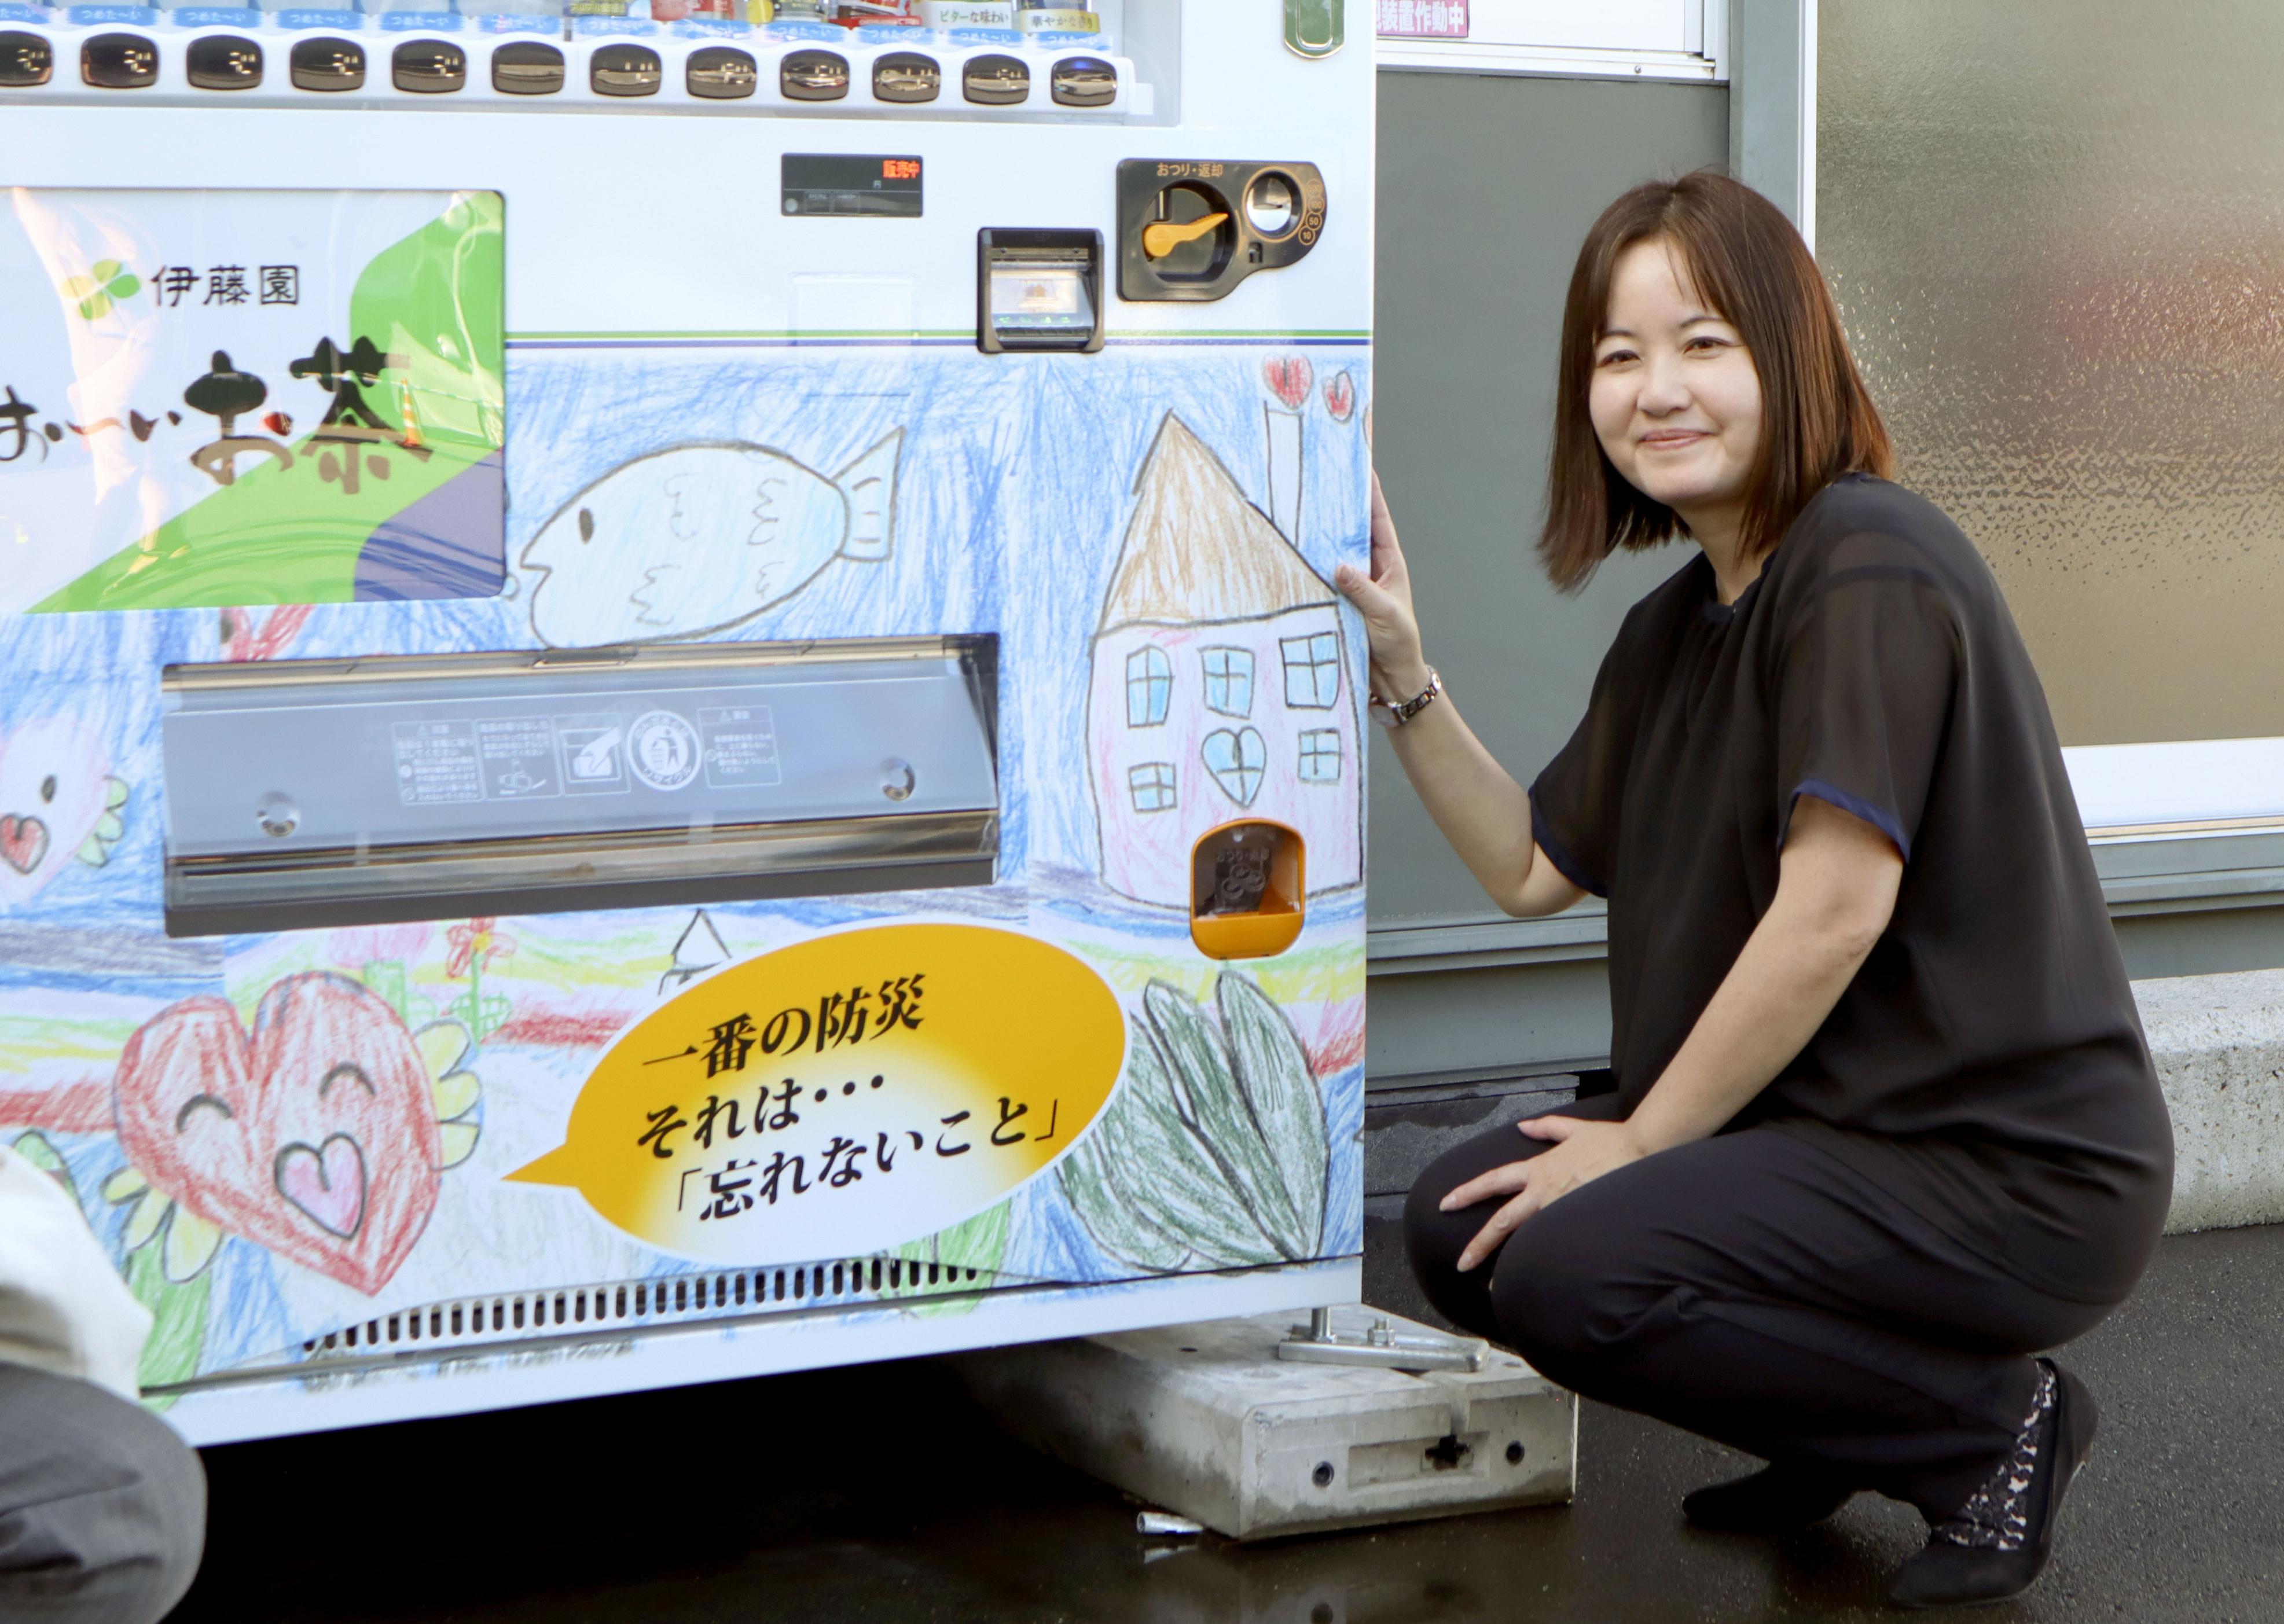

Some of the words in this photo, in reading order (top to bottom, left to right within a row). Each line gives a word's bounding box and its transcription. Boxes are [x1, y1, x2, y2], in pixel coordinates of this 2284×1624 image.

[939, 9, 1009, 24] ビターな味わい
[883, 160, 920, 178] 販売中
[1157, 163, 1223, 178] おつり・返却
[1309, 216, 1319, 225] 50
[1303, 231, 1312, 240] 10
[150, 264, 300, 307] 伊藤園
[642, 972, 927, 1079] 一番の防災
[678, 1097, 1059, 1222] 「忘れないこと」
